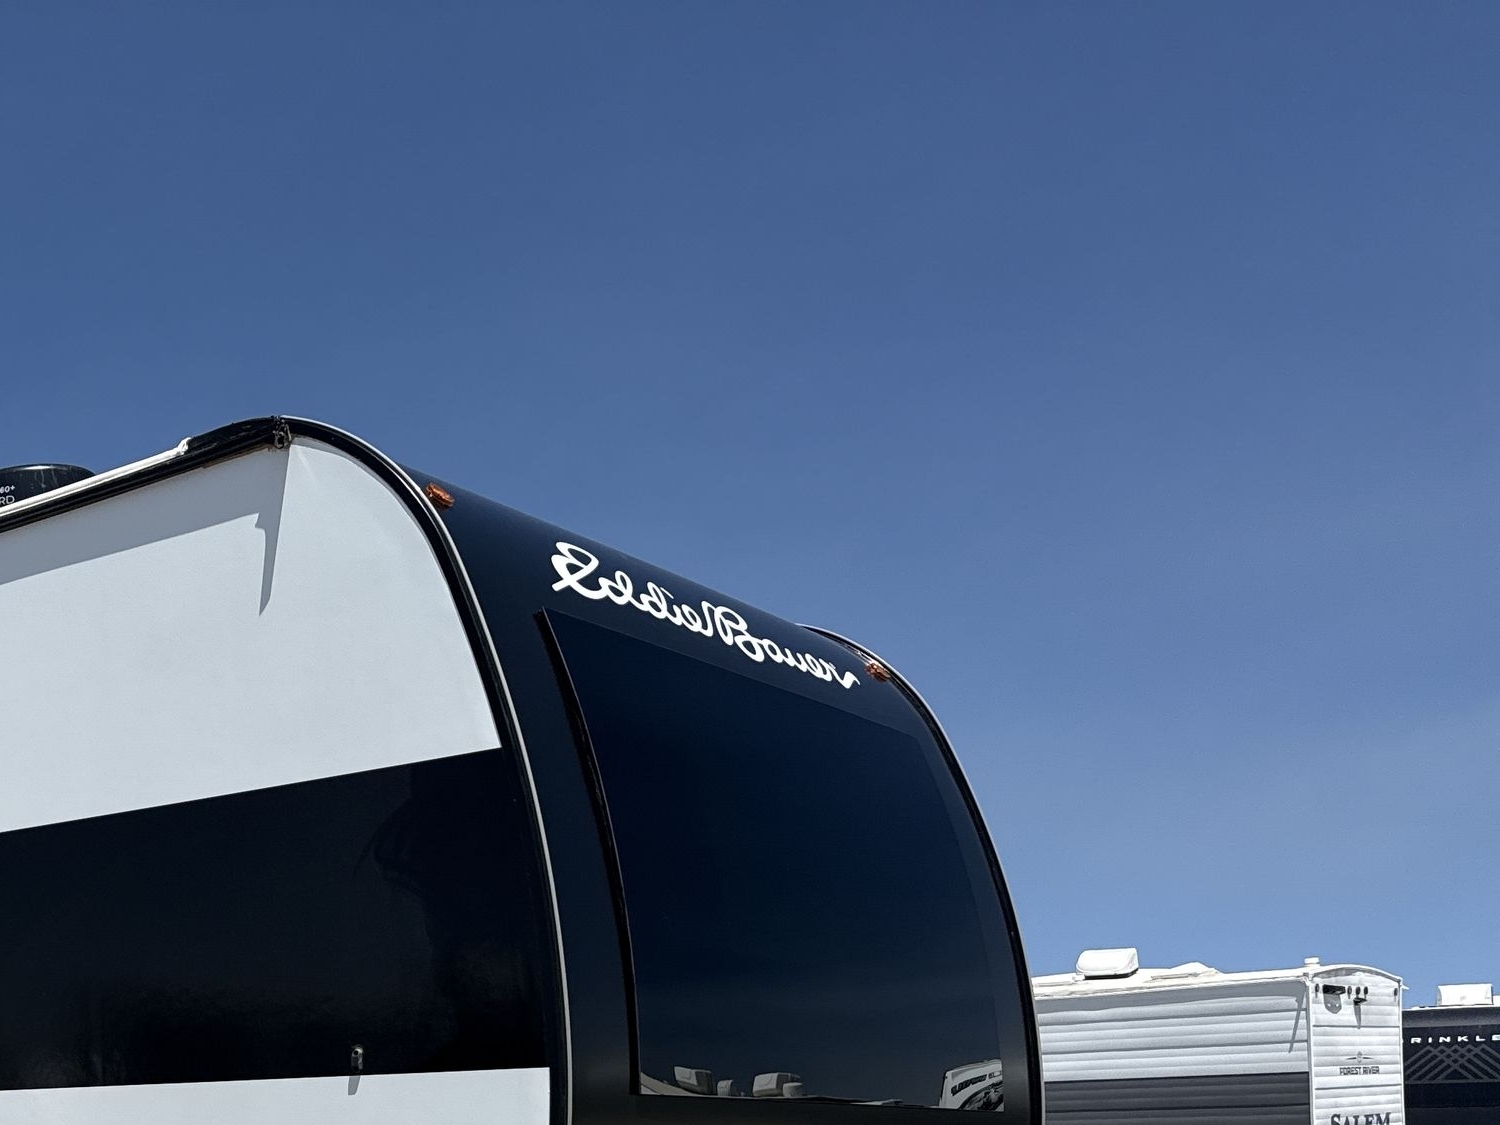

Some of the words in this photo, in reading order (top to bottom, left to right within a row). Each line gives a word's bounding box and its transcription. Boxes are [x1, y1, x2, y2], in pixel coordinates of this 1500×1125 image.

[551, 541, 700, 632] Eddie
[699, 600, 861, 689] Bauer
[1340, 1067, 1361, 1075] FOREST
[1363, 1066, 1380, 1074] RIVER
